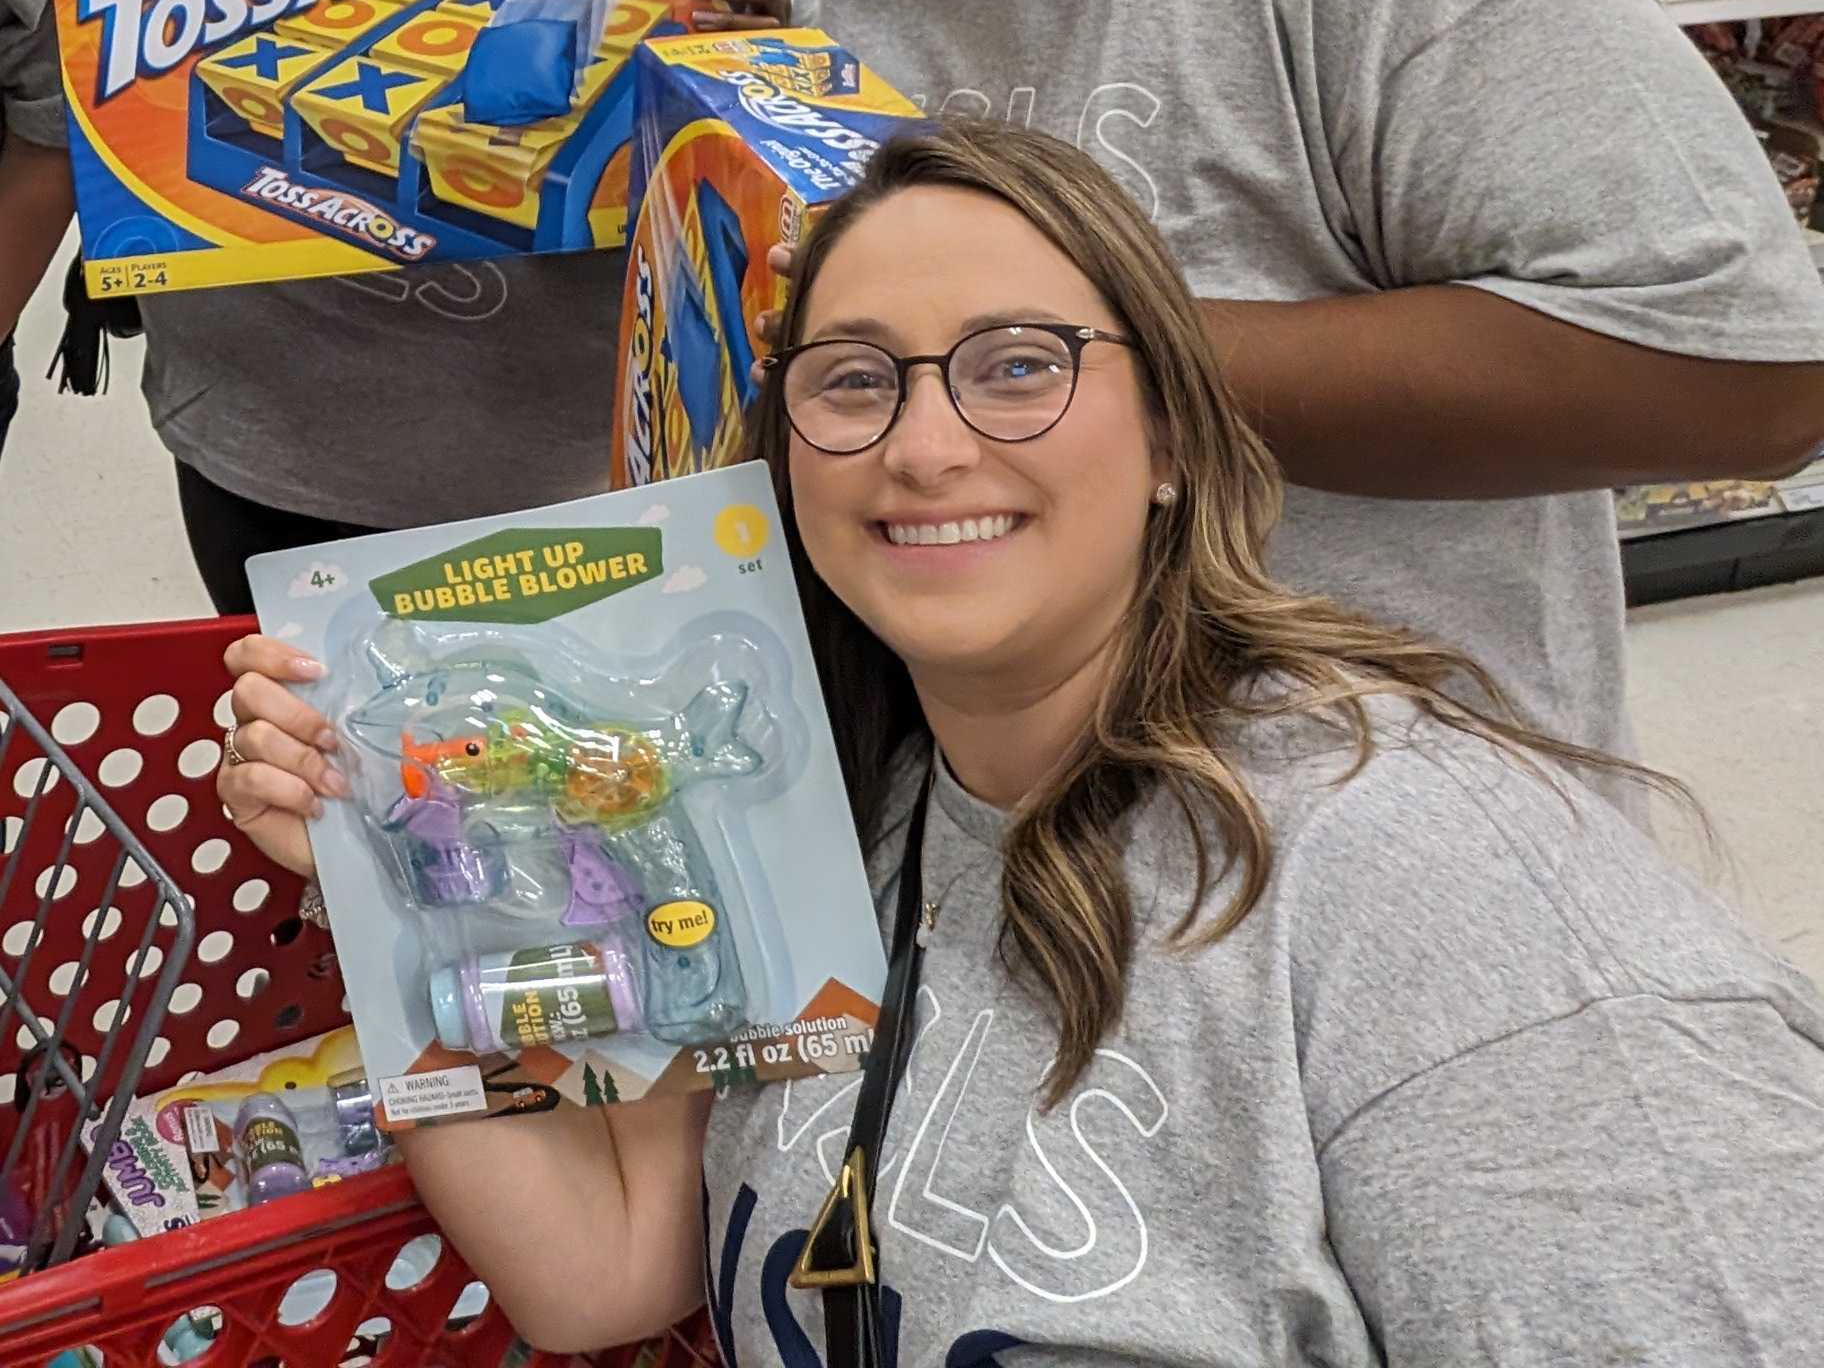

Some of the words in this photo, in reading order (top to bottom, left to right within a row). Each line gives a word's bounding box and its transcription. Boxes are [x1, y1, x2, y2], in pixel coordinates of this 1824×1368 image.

[102, 276, 123, 292] 5+
[134, 271, 168, 288] 2-4
[444, 549, 534, 586] LIGHT
[543, 541, 585, 569] UP
[738, 559, 764, 575] set
[309, 570, 336, 589] 4+
[394, 583, 512, 616] BUBBLE
[521, 552, 648, 596] BLOWER
[650, 919, 673, 934] try
[679, 910, 709, 931] me!
[730, 1022, 781, 1043] bubble
[784, 1016, 847, 1036] solution
[693, 1046, 732, 1073] 2.2
[735, 1043, 757, 1067] fl
[762, 1042, 793, 1064] oz
[797, 1032, 838, 1063] (65
[405, 1075, 451, 1092] WARNING
